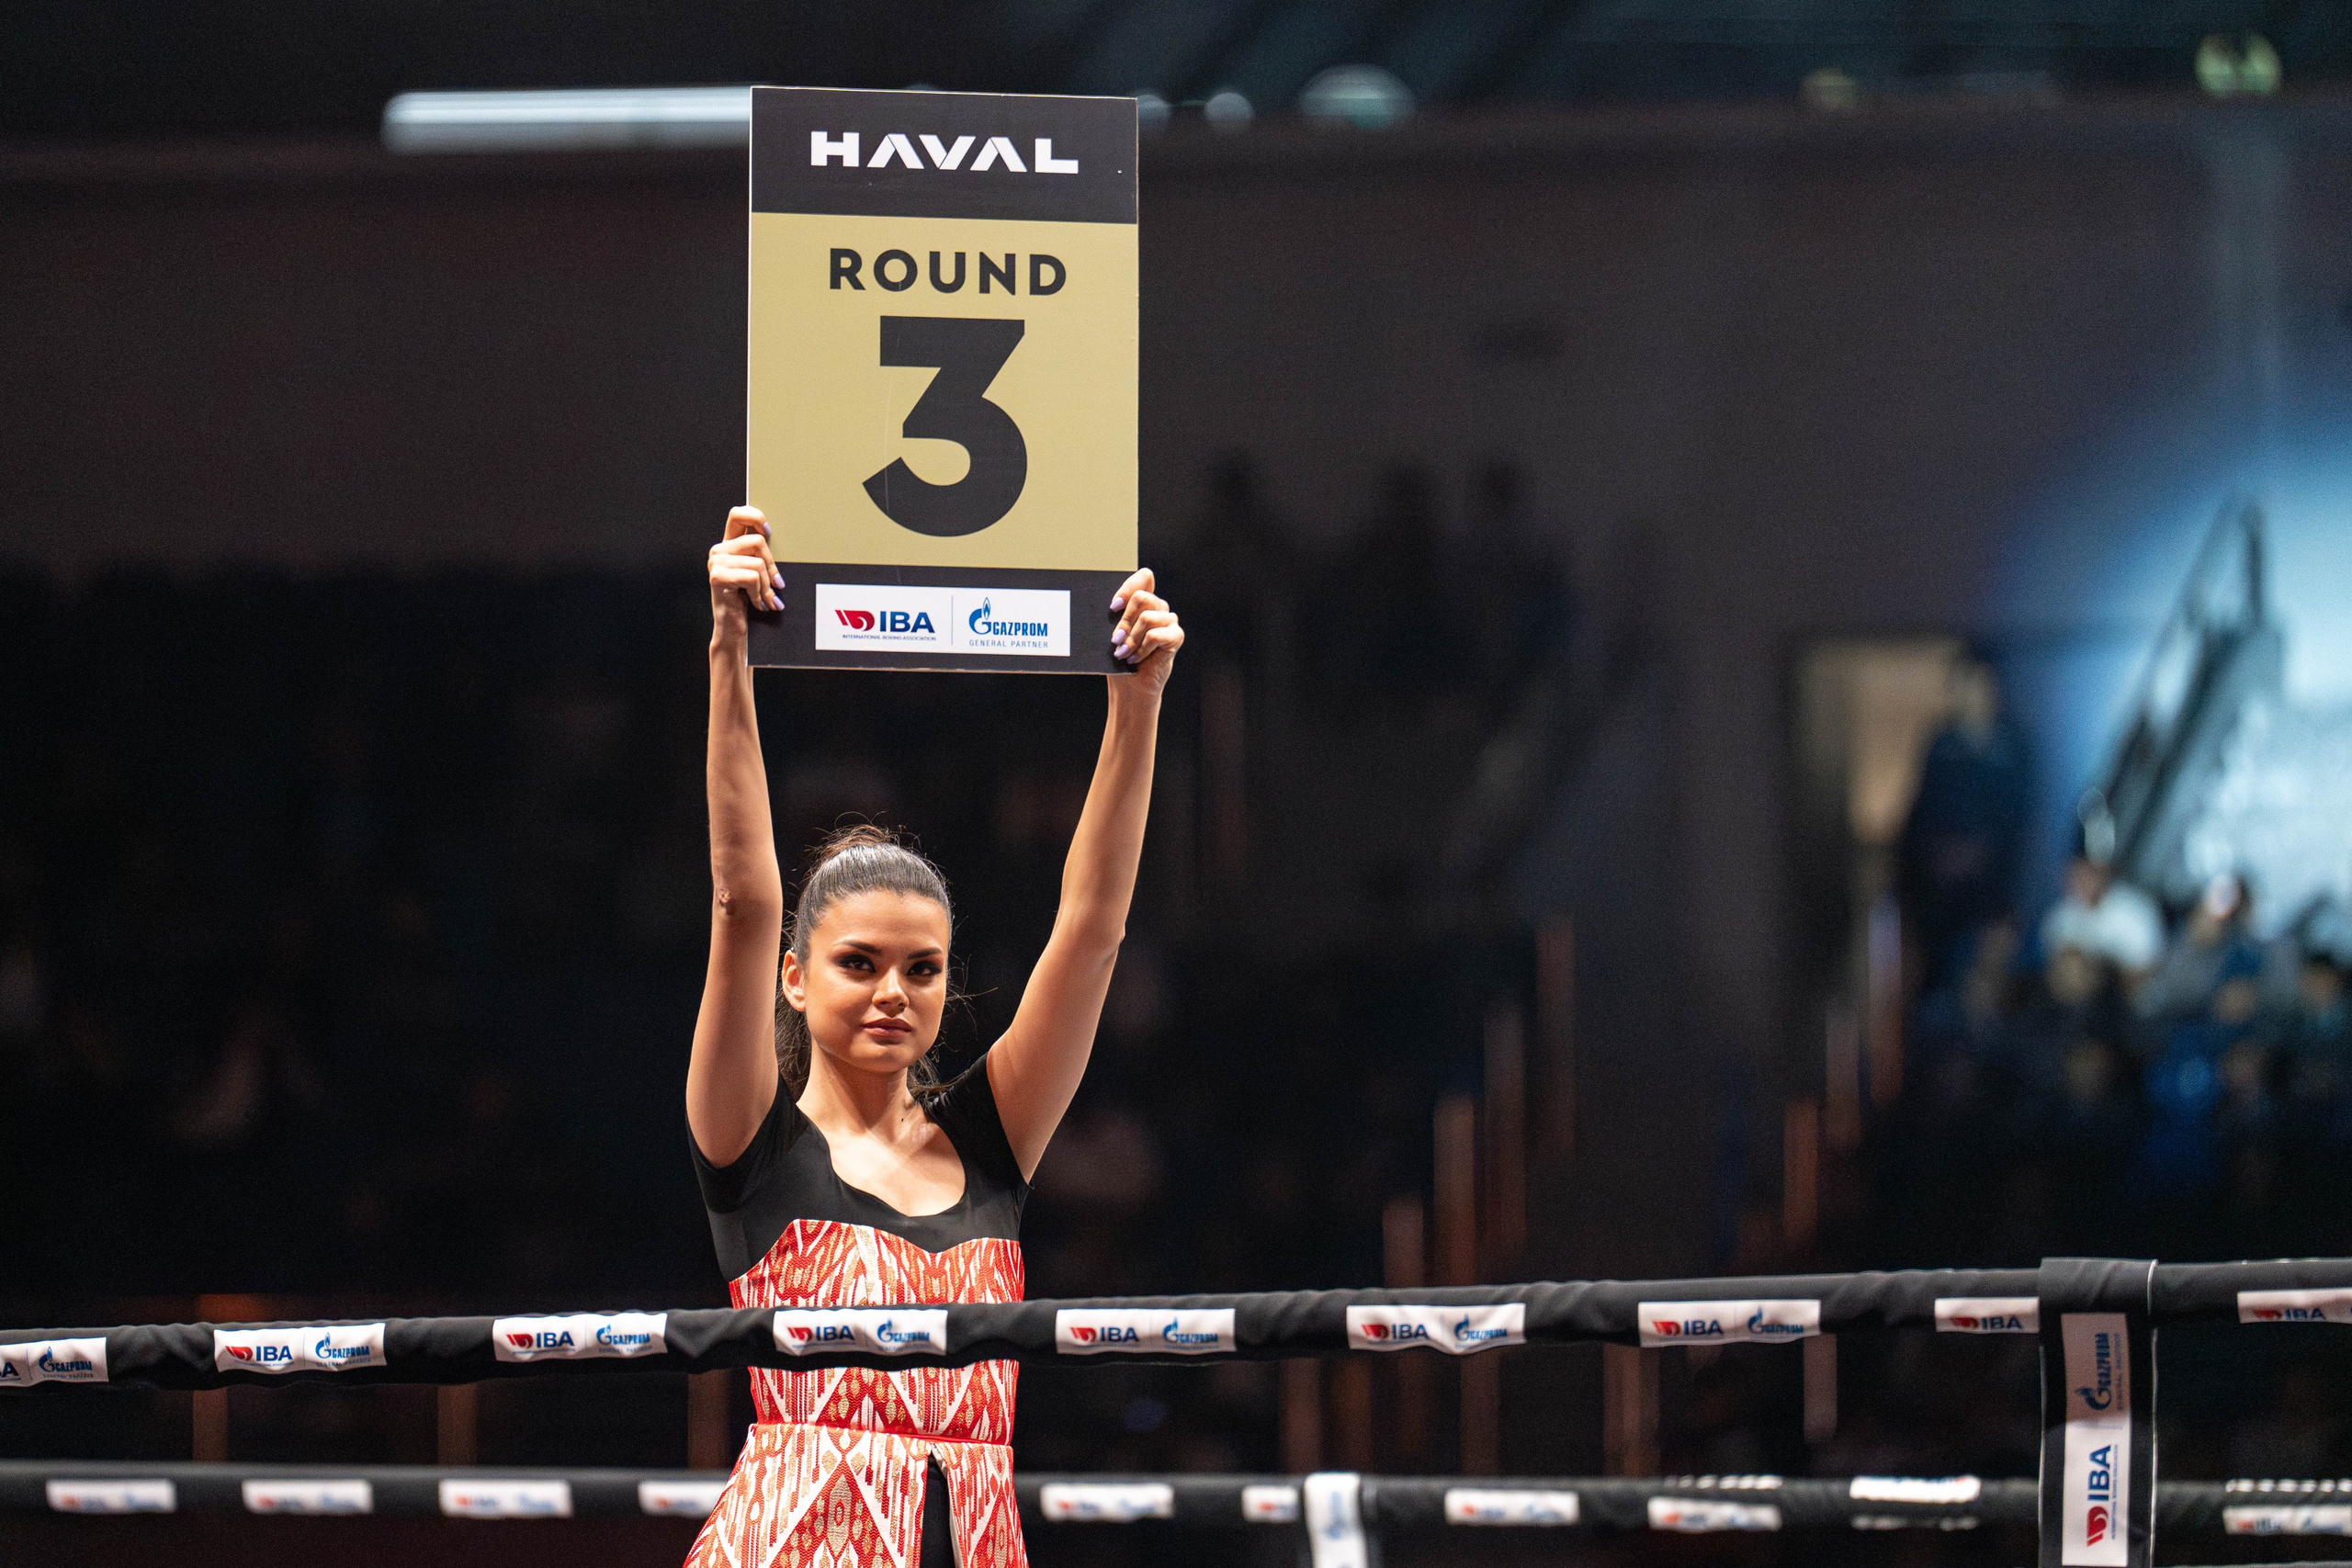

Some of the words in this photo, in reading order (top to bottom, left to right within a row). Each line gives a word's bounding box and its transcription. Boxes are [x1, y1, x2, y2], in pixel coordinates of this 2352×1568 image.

[810, 130, 1080, 175] HAVAL
[830, 247, 1067, 296] ROUND
[862, 315, 1028, 537] 3
[879, 610, 935, 633] IBA
[992, 621, 1048, 637] GAZPROM
[969, 639, 1007, 648] GENERAL
[1011, 640, 1048, 649] PARTNER
[1683, 1320, 1724, 1336] IBA
[1981, 1315, 2022, 1330] IBA
[536, 1331, 575, 1348] IBA
[815, 1325, 854, 1341] IBA
[1100, 1327, 1139, 1342] IBA
[1391, 1324, 1430, 1340] IBA
[255, 1345, 293, 1361] IBA
[2087, 1445, 2111, 1502] IBA
